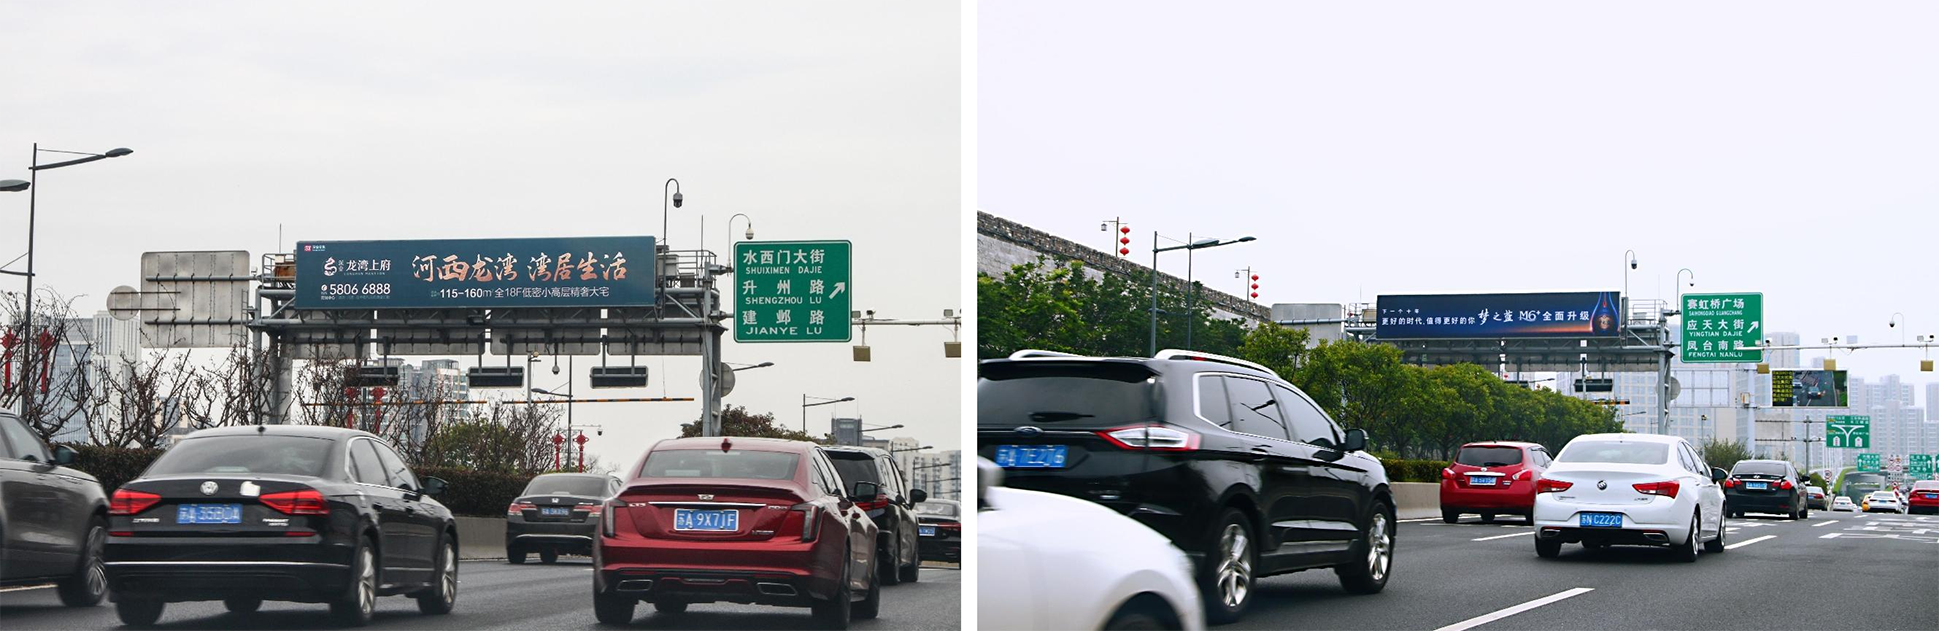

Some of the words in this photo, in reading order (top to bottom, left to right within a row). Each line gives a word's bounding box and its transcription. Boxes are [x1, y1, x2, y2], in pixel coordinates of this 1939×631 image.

[743, 249, 825, 265] 水西门大街
[346, 259, 391, 271] 龙湾上府
[412, 253, 518, 282] 河西龙湾
[527, 251, 627, 282] 湾居生活
[745, 266, 790, 275] SHUIXIMEN
[798, 266, 822, 274] DAJIE
[329, 283, 358, 295] 5806
[361, 283, 391, 295] 6888
[742, 279, 825, 295] 升州路
[745, 297, 803, 305] SHENGZHOU
[809, 296, 822, 304] LU
[1687, 298, 1744, 310] 赛虹桥广场
[742, 309, 825, 325] 建邺路
[1542, 310, 1590, 321] 全面升级
[1687, 318, 1744, 330] 应天大街
[746, 327, 798, 335] JIANYE
[806, 327, 822, 335] LU
